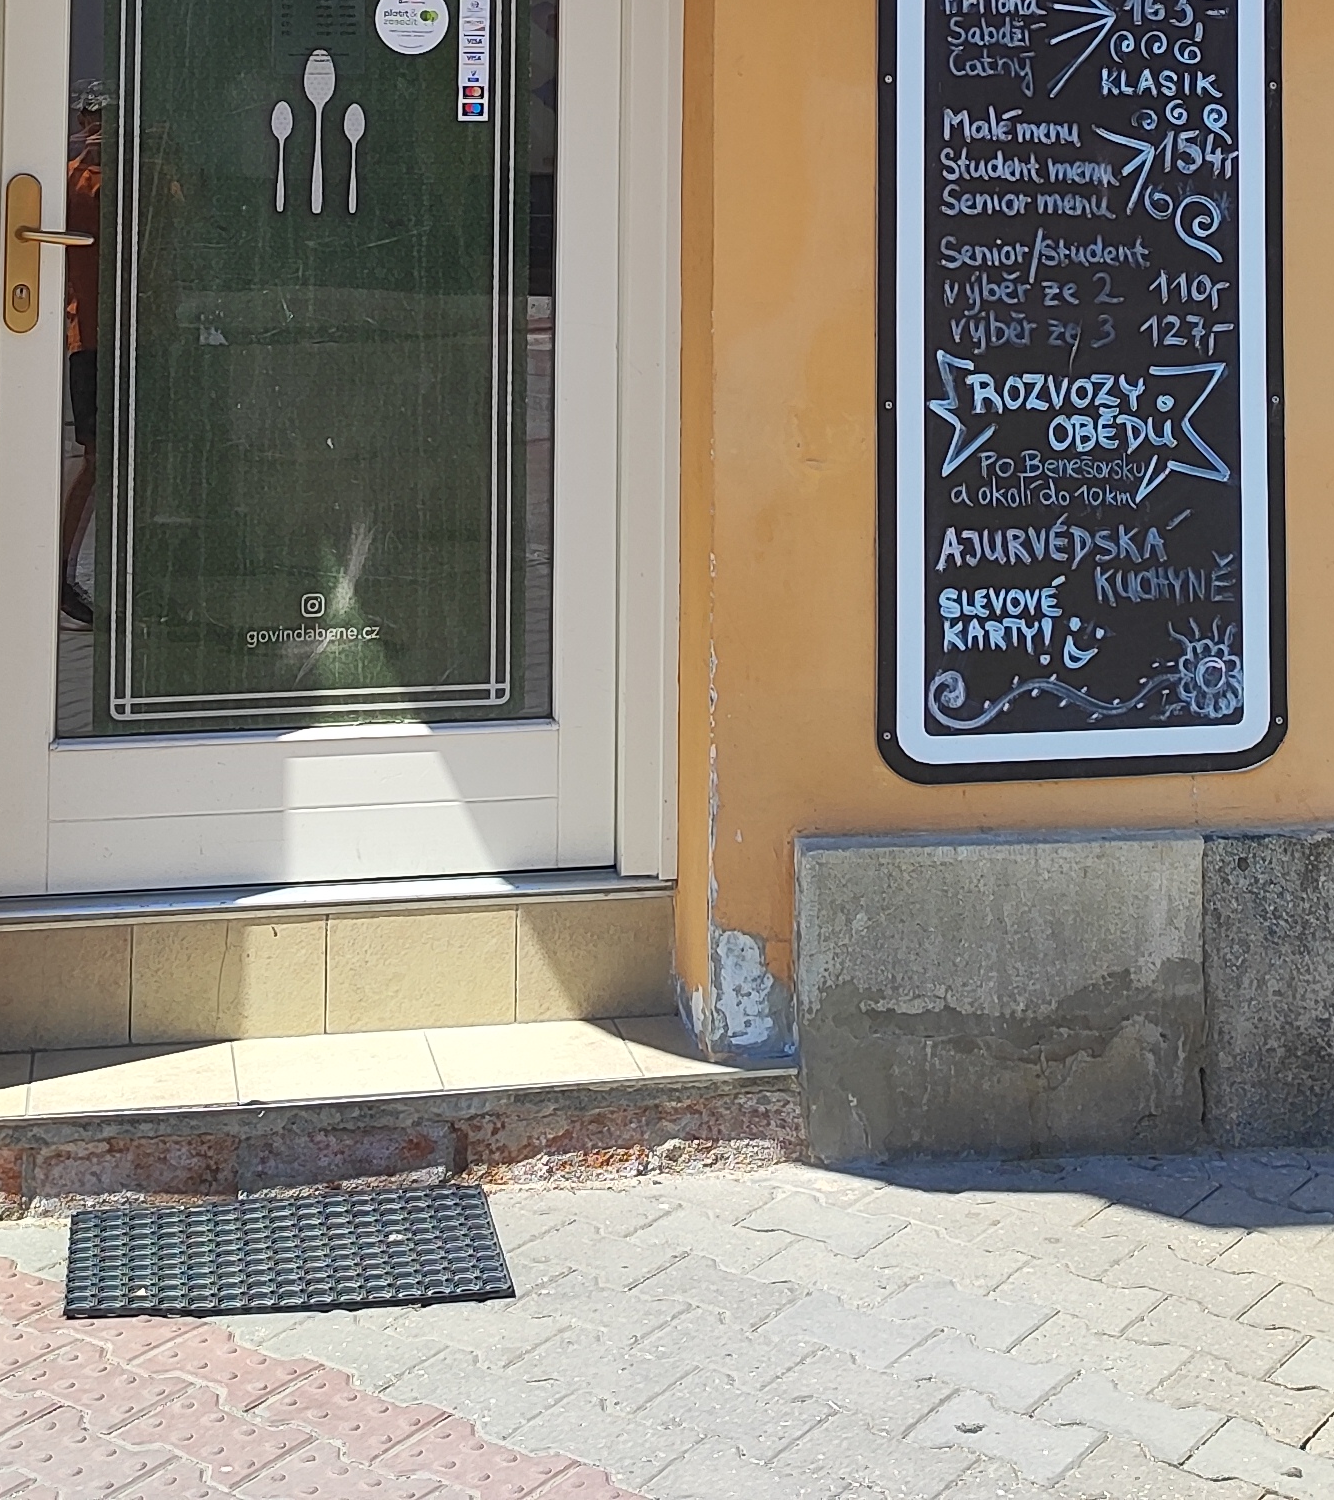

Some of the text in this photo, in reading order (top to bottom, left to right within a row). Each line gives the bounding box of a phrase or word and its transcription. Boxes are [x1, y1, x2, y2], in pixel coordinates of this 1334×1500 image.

[947, 18, 1048, 47] Sabdží
[949, 45, 1037, 97] Čatný
[1101, 67, 1224, 99] KLASIK
[942, 106, 1082, 147] Malé menu
[940, 147, 1120, 186] Student menu
[940, 185, 1116, 220] Senior menu
[940, 228, 1151, 283] Senior/Student
[943, 270, 1032, 315] výběr
[1043, 280, 1080, 307] ze
[1093, 272, 1125, 303] 2
[949, 312, 1038, 355] výběr
[1047, 320, 1082, 346] ze
[1090, 315, 1116, 348] 3
[966, 372, 1145, 414] ROZVOZY
[977, 450, 1145, 481] Po Benešovsku
[950, 482, 974, 507] a
[978, 475, 1045, 507] okolí
[1040, 478, 1070, 506] do
[936, 510, 1193, 572] AJURVÉDSKÁ
[938, 576, 1066, 618] SLEVOVÉ
[1094, 550, 1235, 606] KUCHYNĚ
[246, 623, 380, 648] govindabene.cz
[943, 617, 1052, 665] KARTY!
